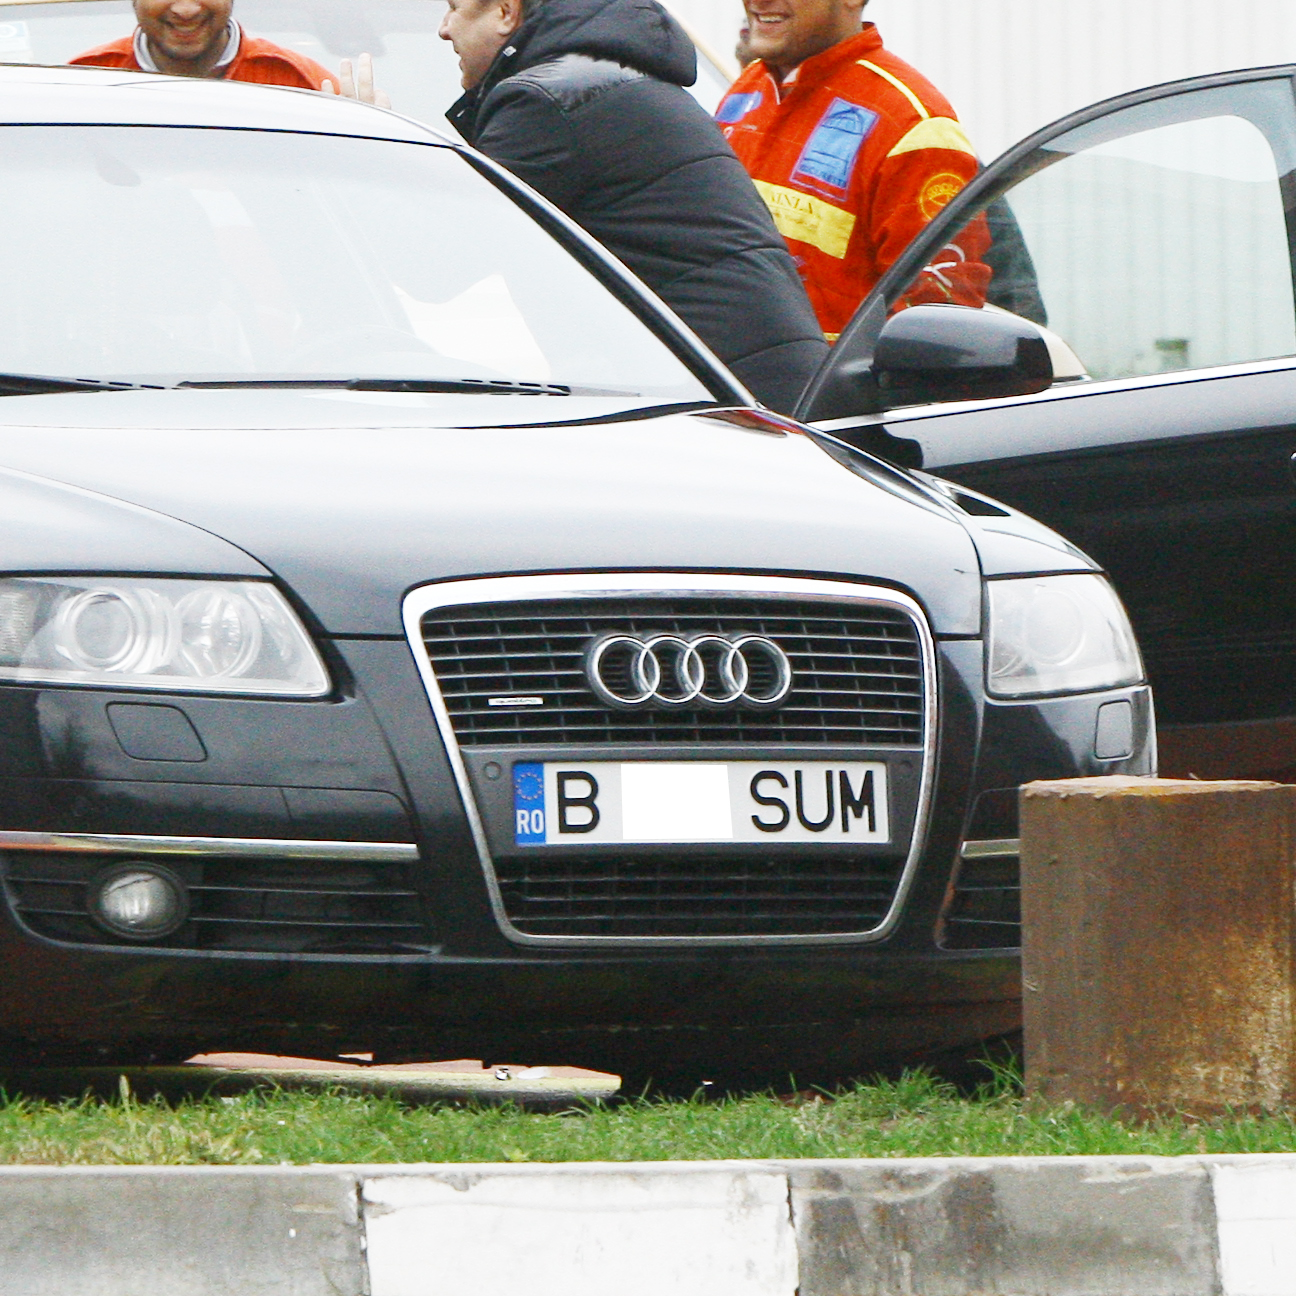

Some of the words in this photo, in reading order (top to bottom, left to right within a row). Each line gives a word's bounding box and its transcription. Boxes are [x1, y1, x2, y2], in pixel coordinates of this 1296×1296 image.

[516, 809, 544, 834] RO
[556, 770, 600, 834] B
[749, 769, 877, 834] SUM
